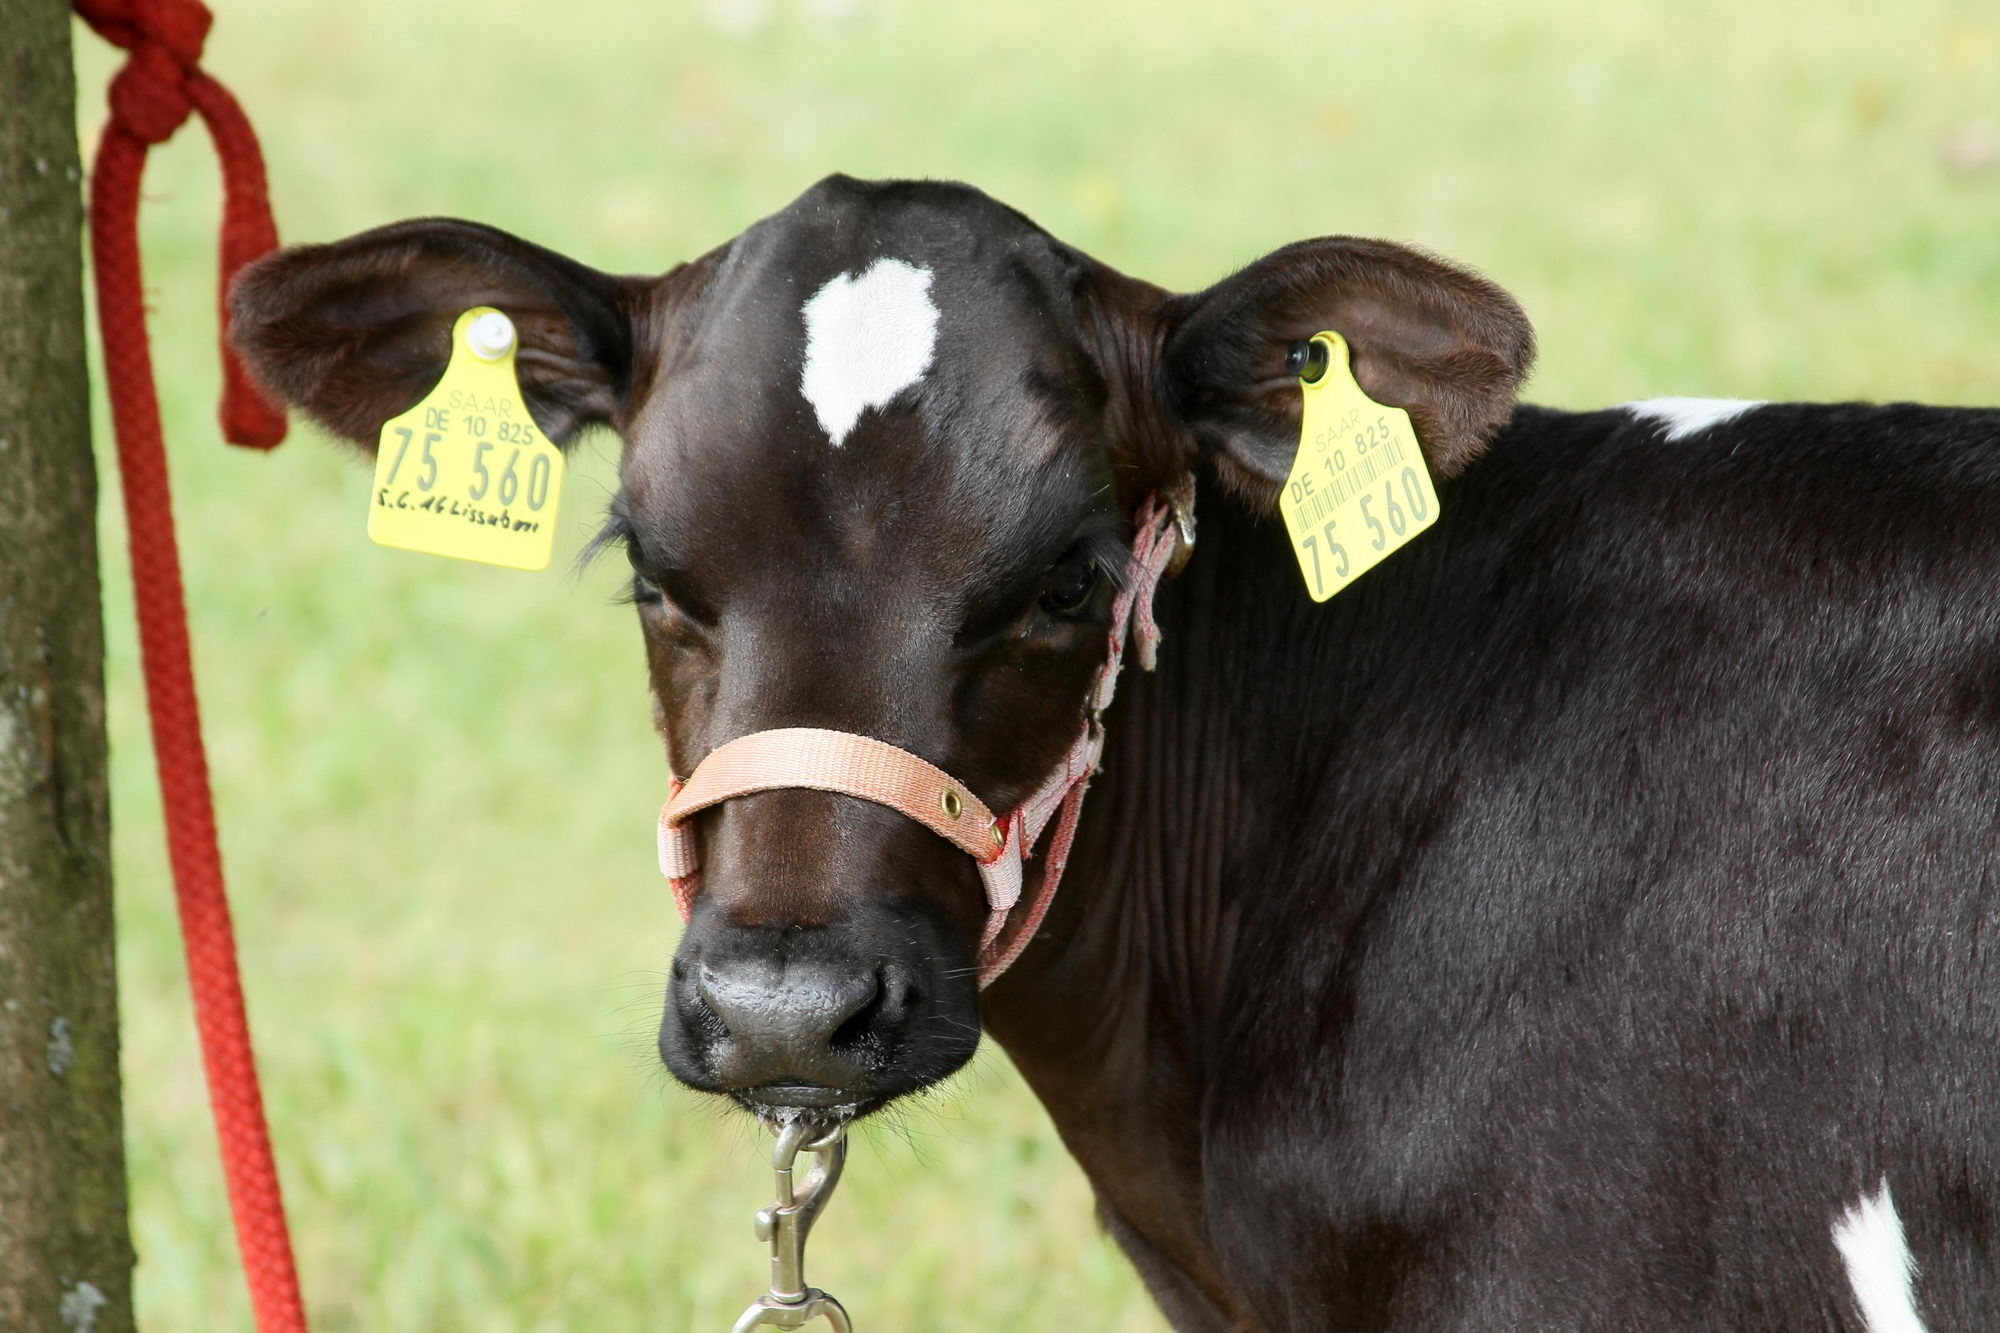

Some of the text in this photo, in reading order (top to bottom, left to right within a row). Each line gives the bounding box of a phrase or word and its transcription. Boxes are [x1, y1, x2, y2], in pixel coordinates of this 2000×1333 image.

[425, 407, 535, 446] DE 10 825
[449, 390, 513, 417] SAAR
[1315, 408, 1361, 454] SAAR
[386, 426, 551, 512] 75 560
[1290, 416, 1390, 504] DE 10 825
[1302, 466, 1428, 595] 75 560
